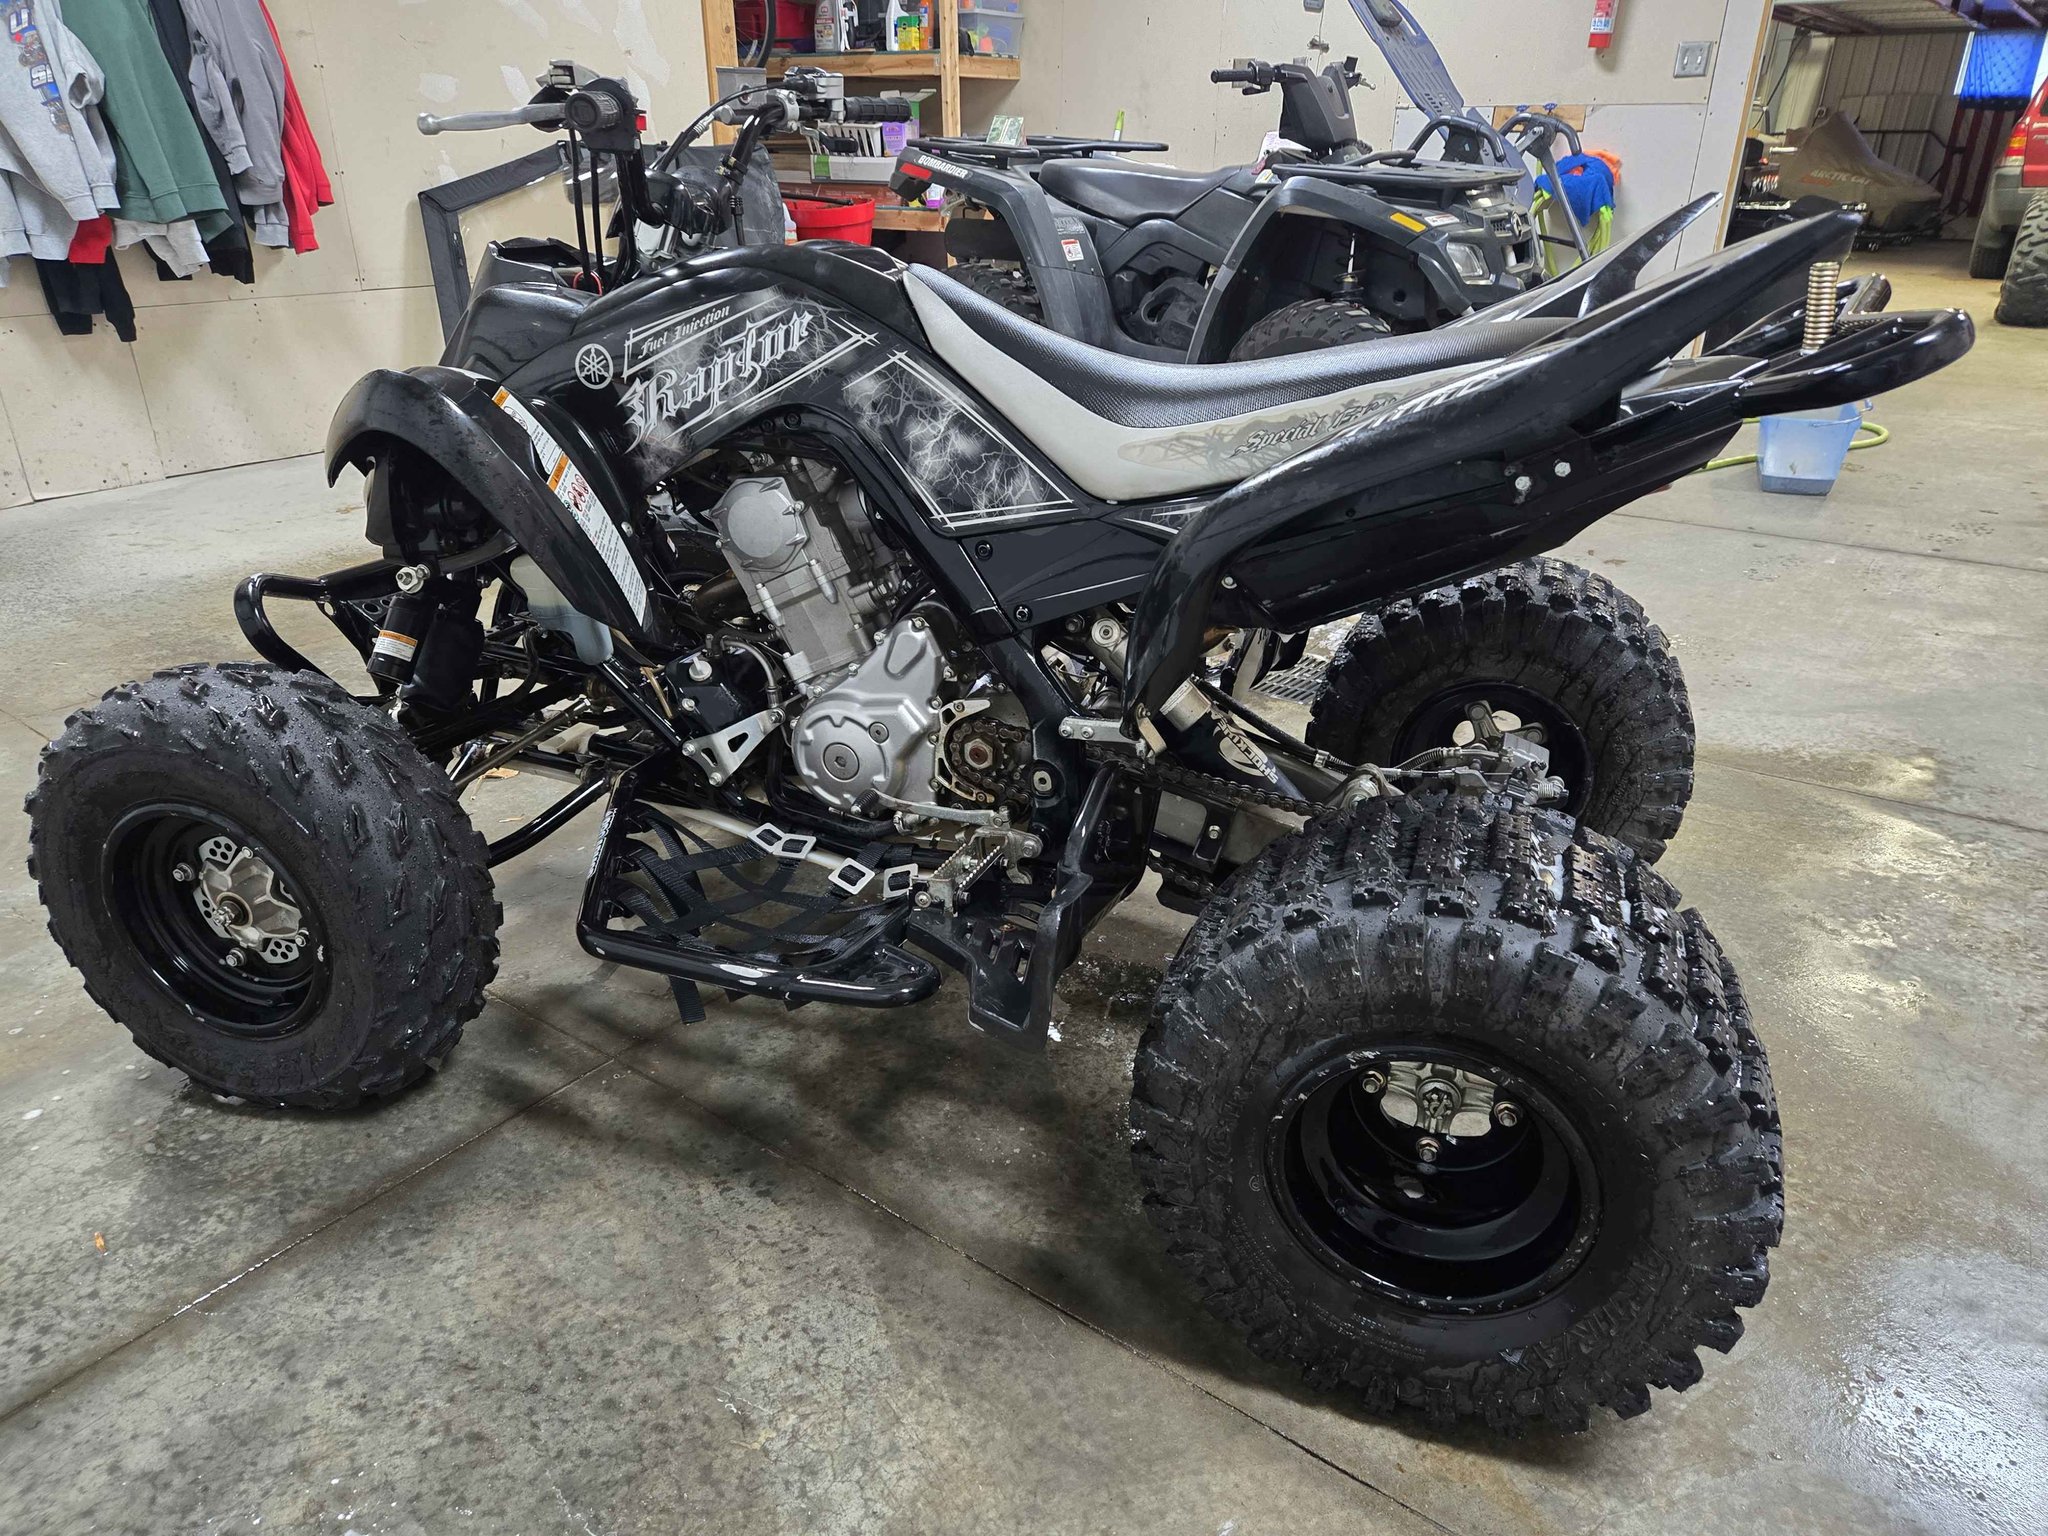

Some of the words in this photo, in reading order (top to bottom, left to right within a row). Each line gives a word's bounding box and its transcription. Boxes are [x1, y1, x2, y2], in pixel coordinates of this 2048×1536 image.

[918, 155, 969, 179] BOMBARDIER
[1811, 169, 1849, 182] ARCTIC
[1851, 175, 1872, 185] CAT
[637, 333, 668, 359] Fuel
[671, 305, 730, 343] Injection
[617, 310, 814, 453] Raptor
[1228, 414, 1328, 458] Special
[1210, 709, 1279, 784] SHOCKWEA
